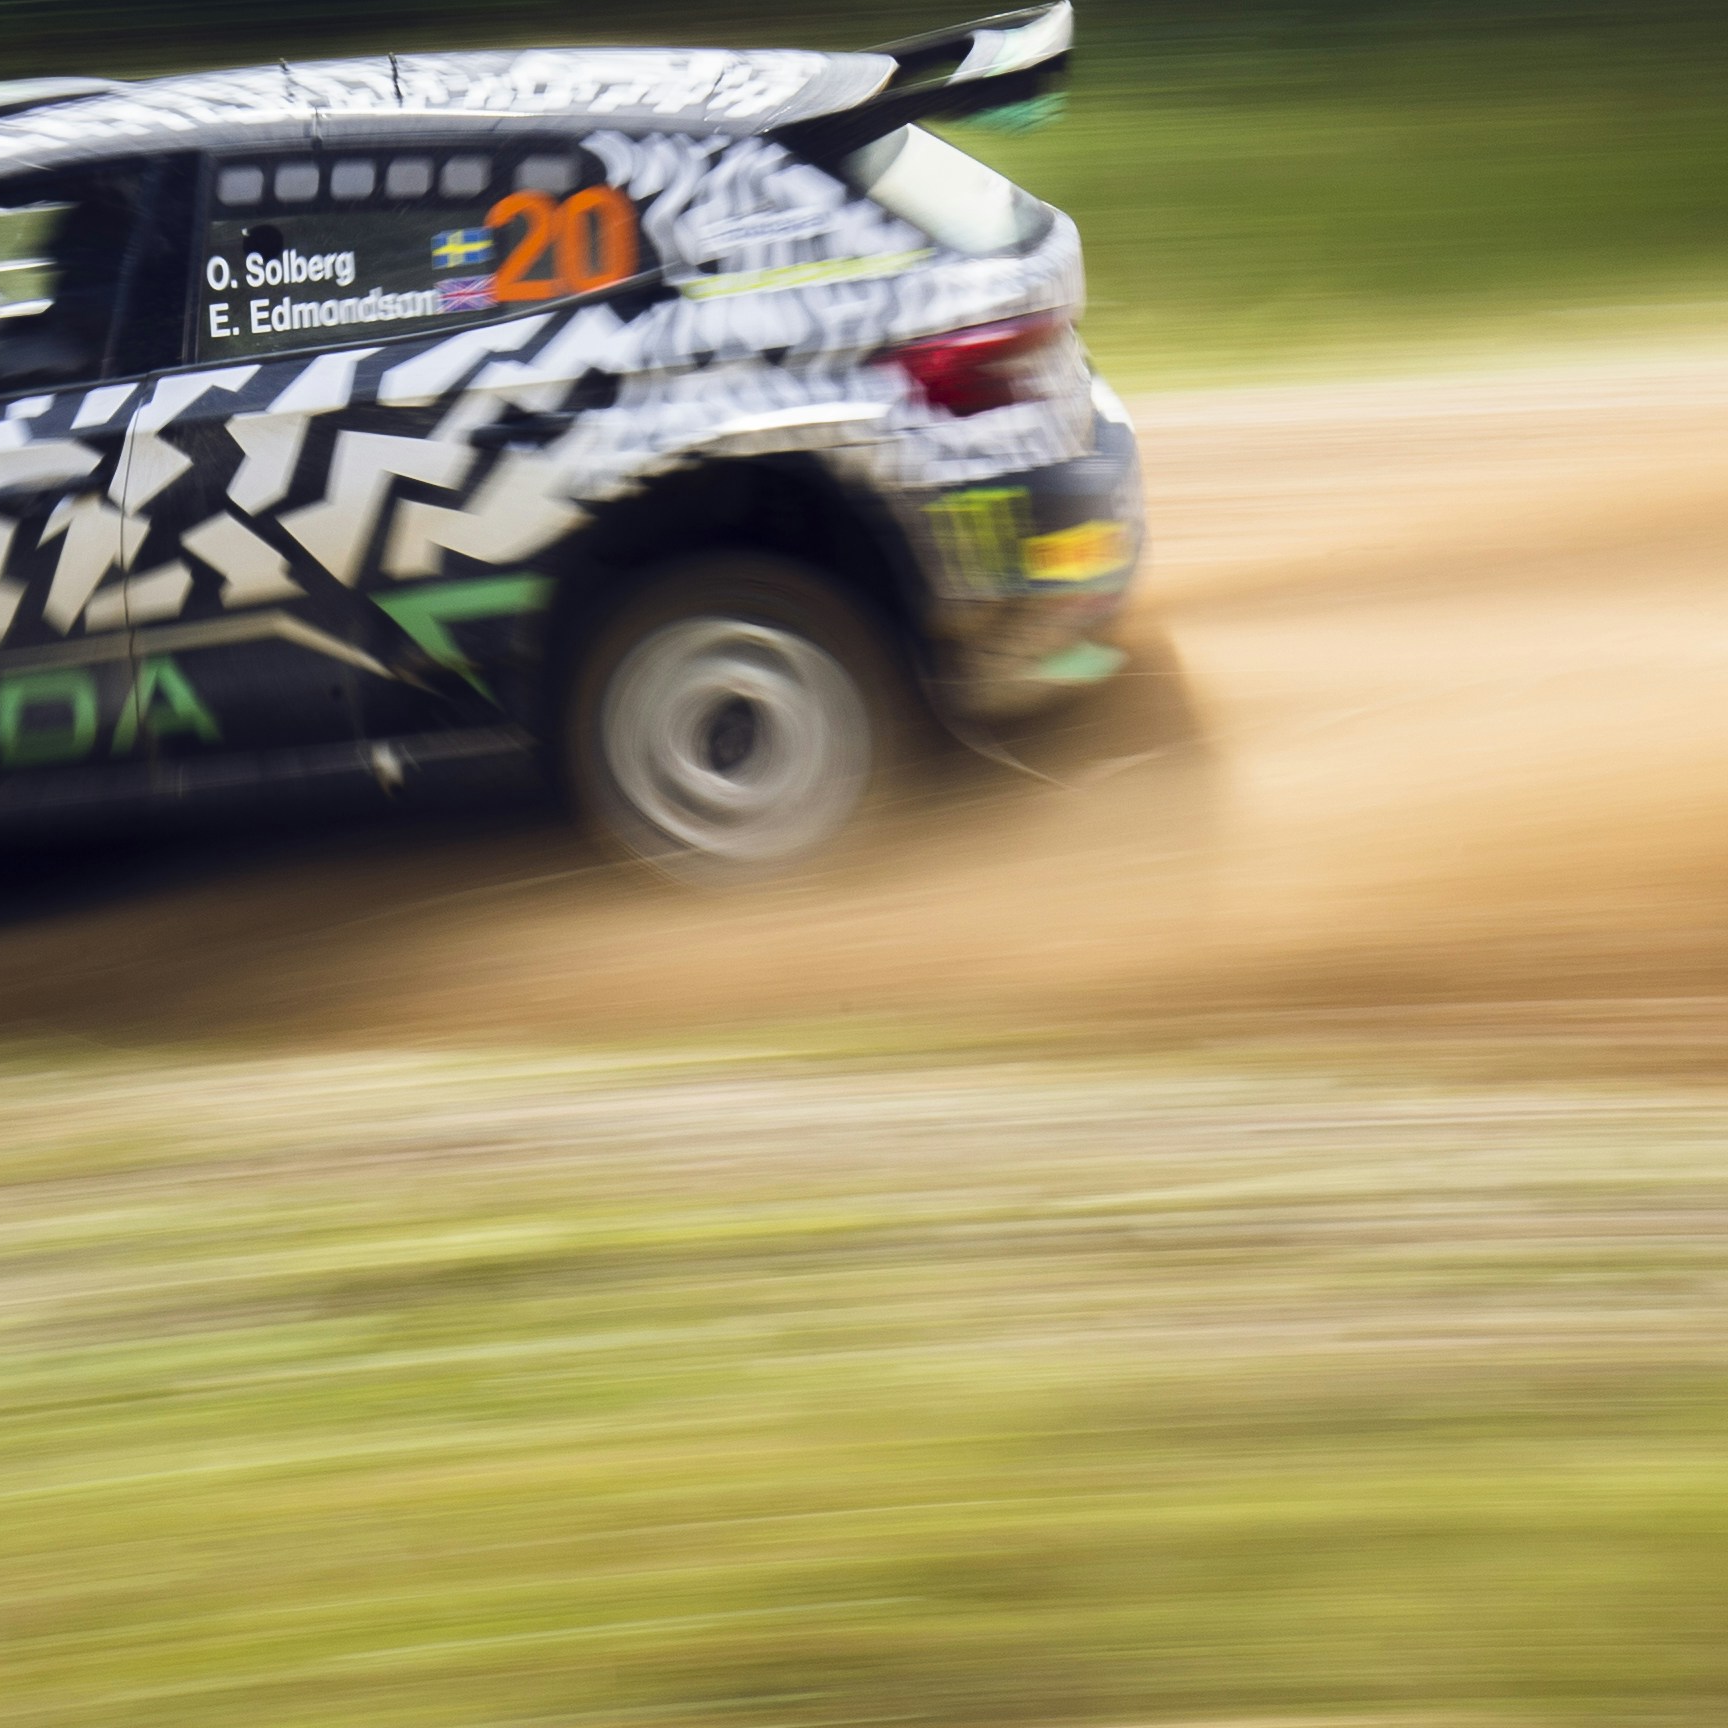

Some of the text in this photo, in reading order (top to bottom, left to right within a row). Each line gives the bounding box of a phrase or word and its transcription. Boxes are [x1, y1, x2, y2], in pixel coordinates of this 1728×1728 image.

[483, 185, 640, 302] 20
[206, 249, 356, 291] O. Solberg
[208, 286, 442, 338] E. Edmondson
